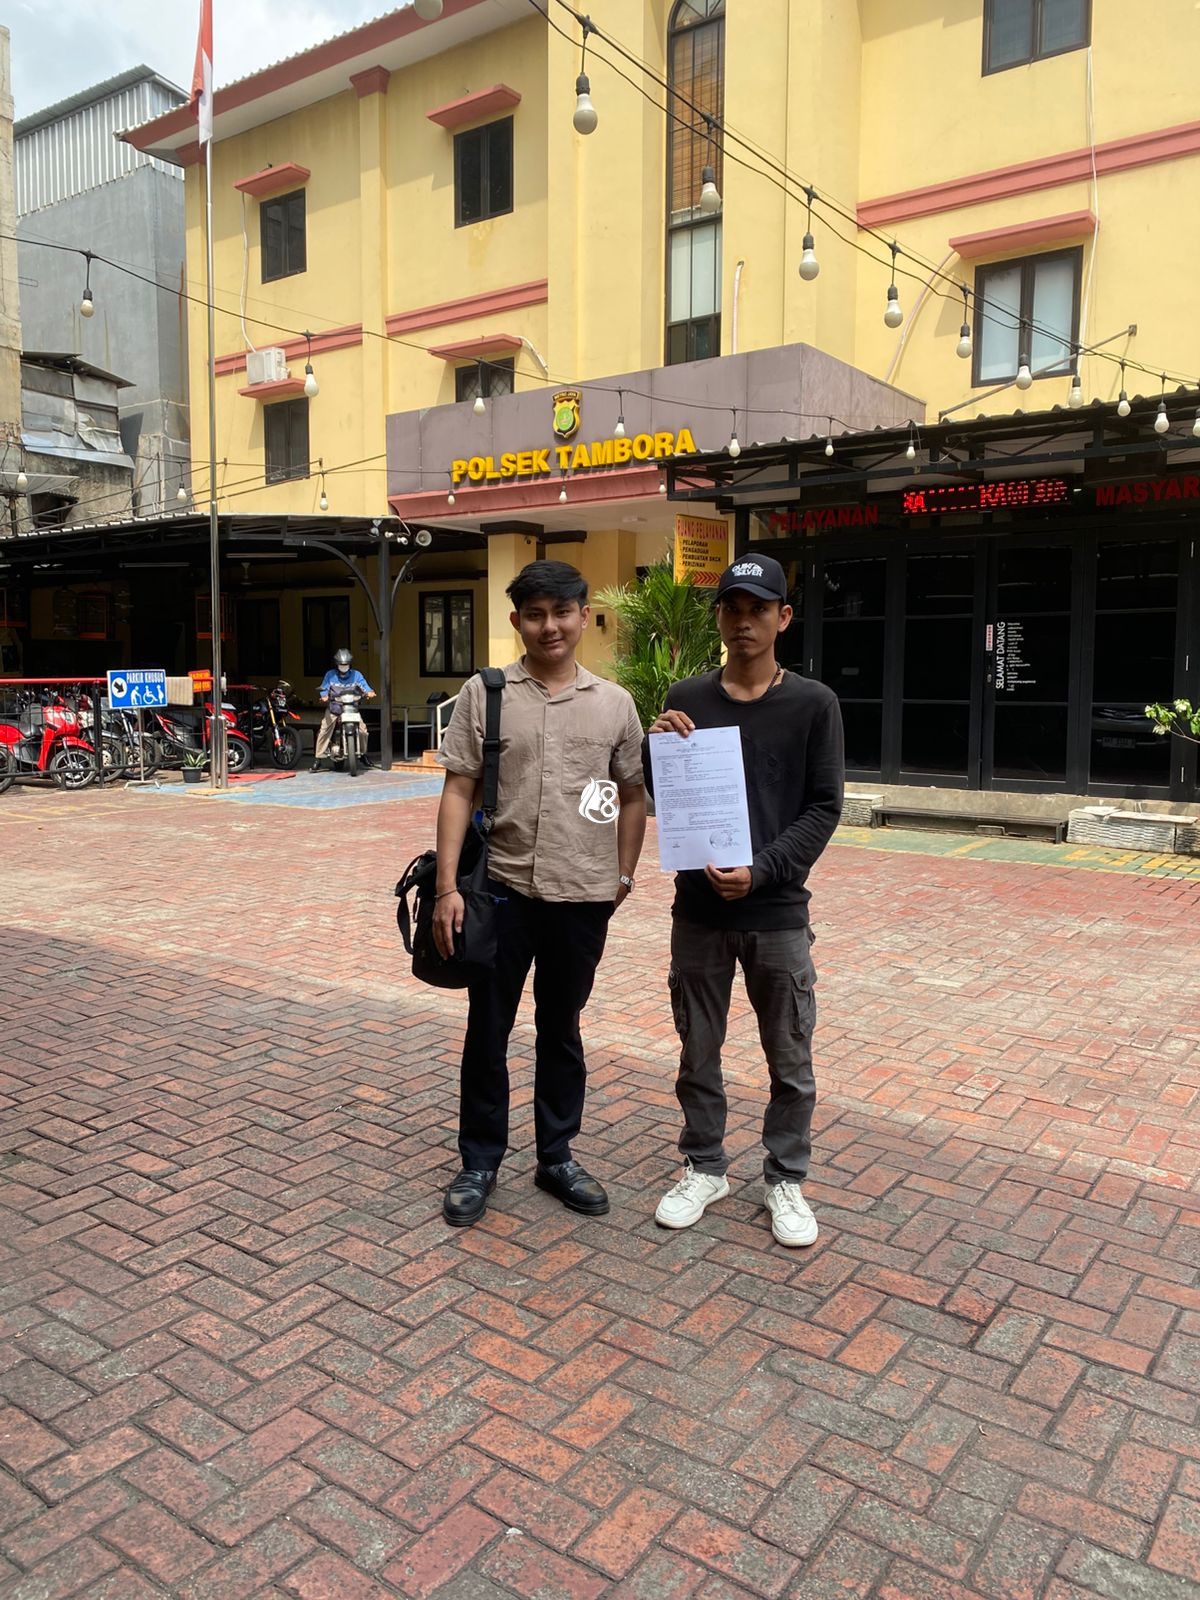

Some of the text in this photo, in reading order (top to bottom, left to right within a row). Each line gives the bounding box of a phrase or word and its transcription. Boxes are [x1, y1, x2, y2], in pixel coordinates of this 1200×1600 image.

[452, 428, 697, 483] POLSEK TAMBORA
[1096, 475, 1200, 507] MASYAR
[768, 502, 879, 532] PELAYANAN
[995, 621, 1006, 689] SELAMAT DATANG
[126, 672, 164, 683] PARKIR KHUSUS
